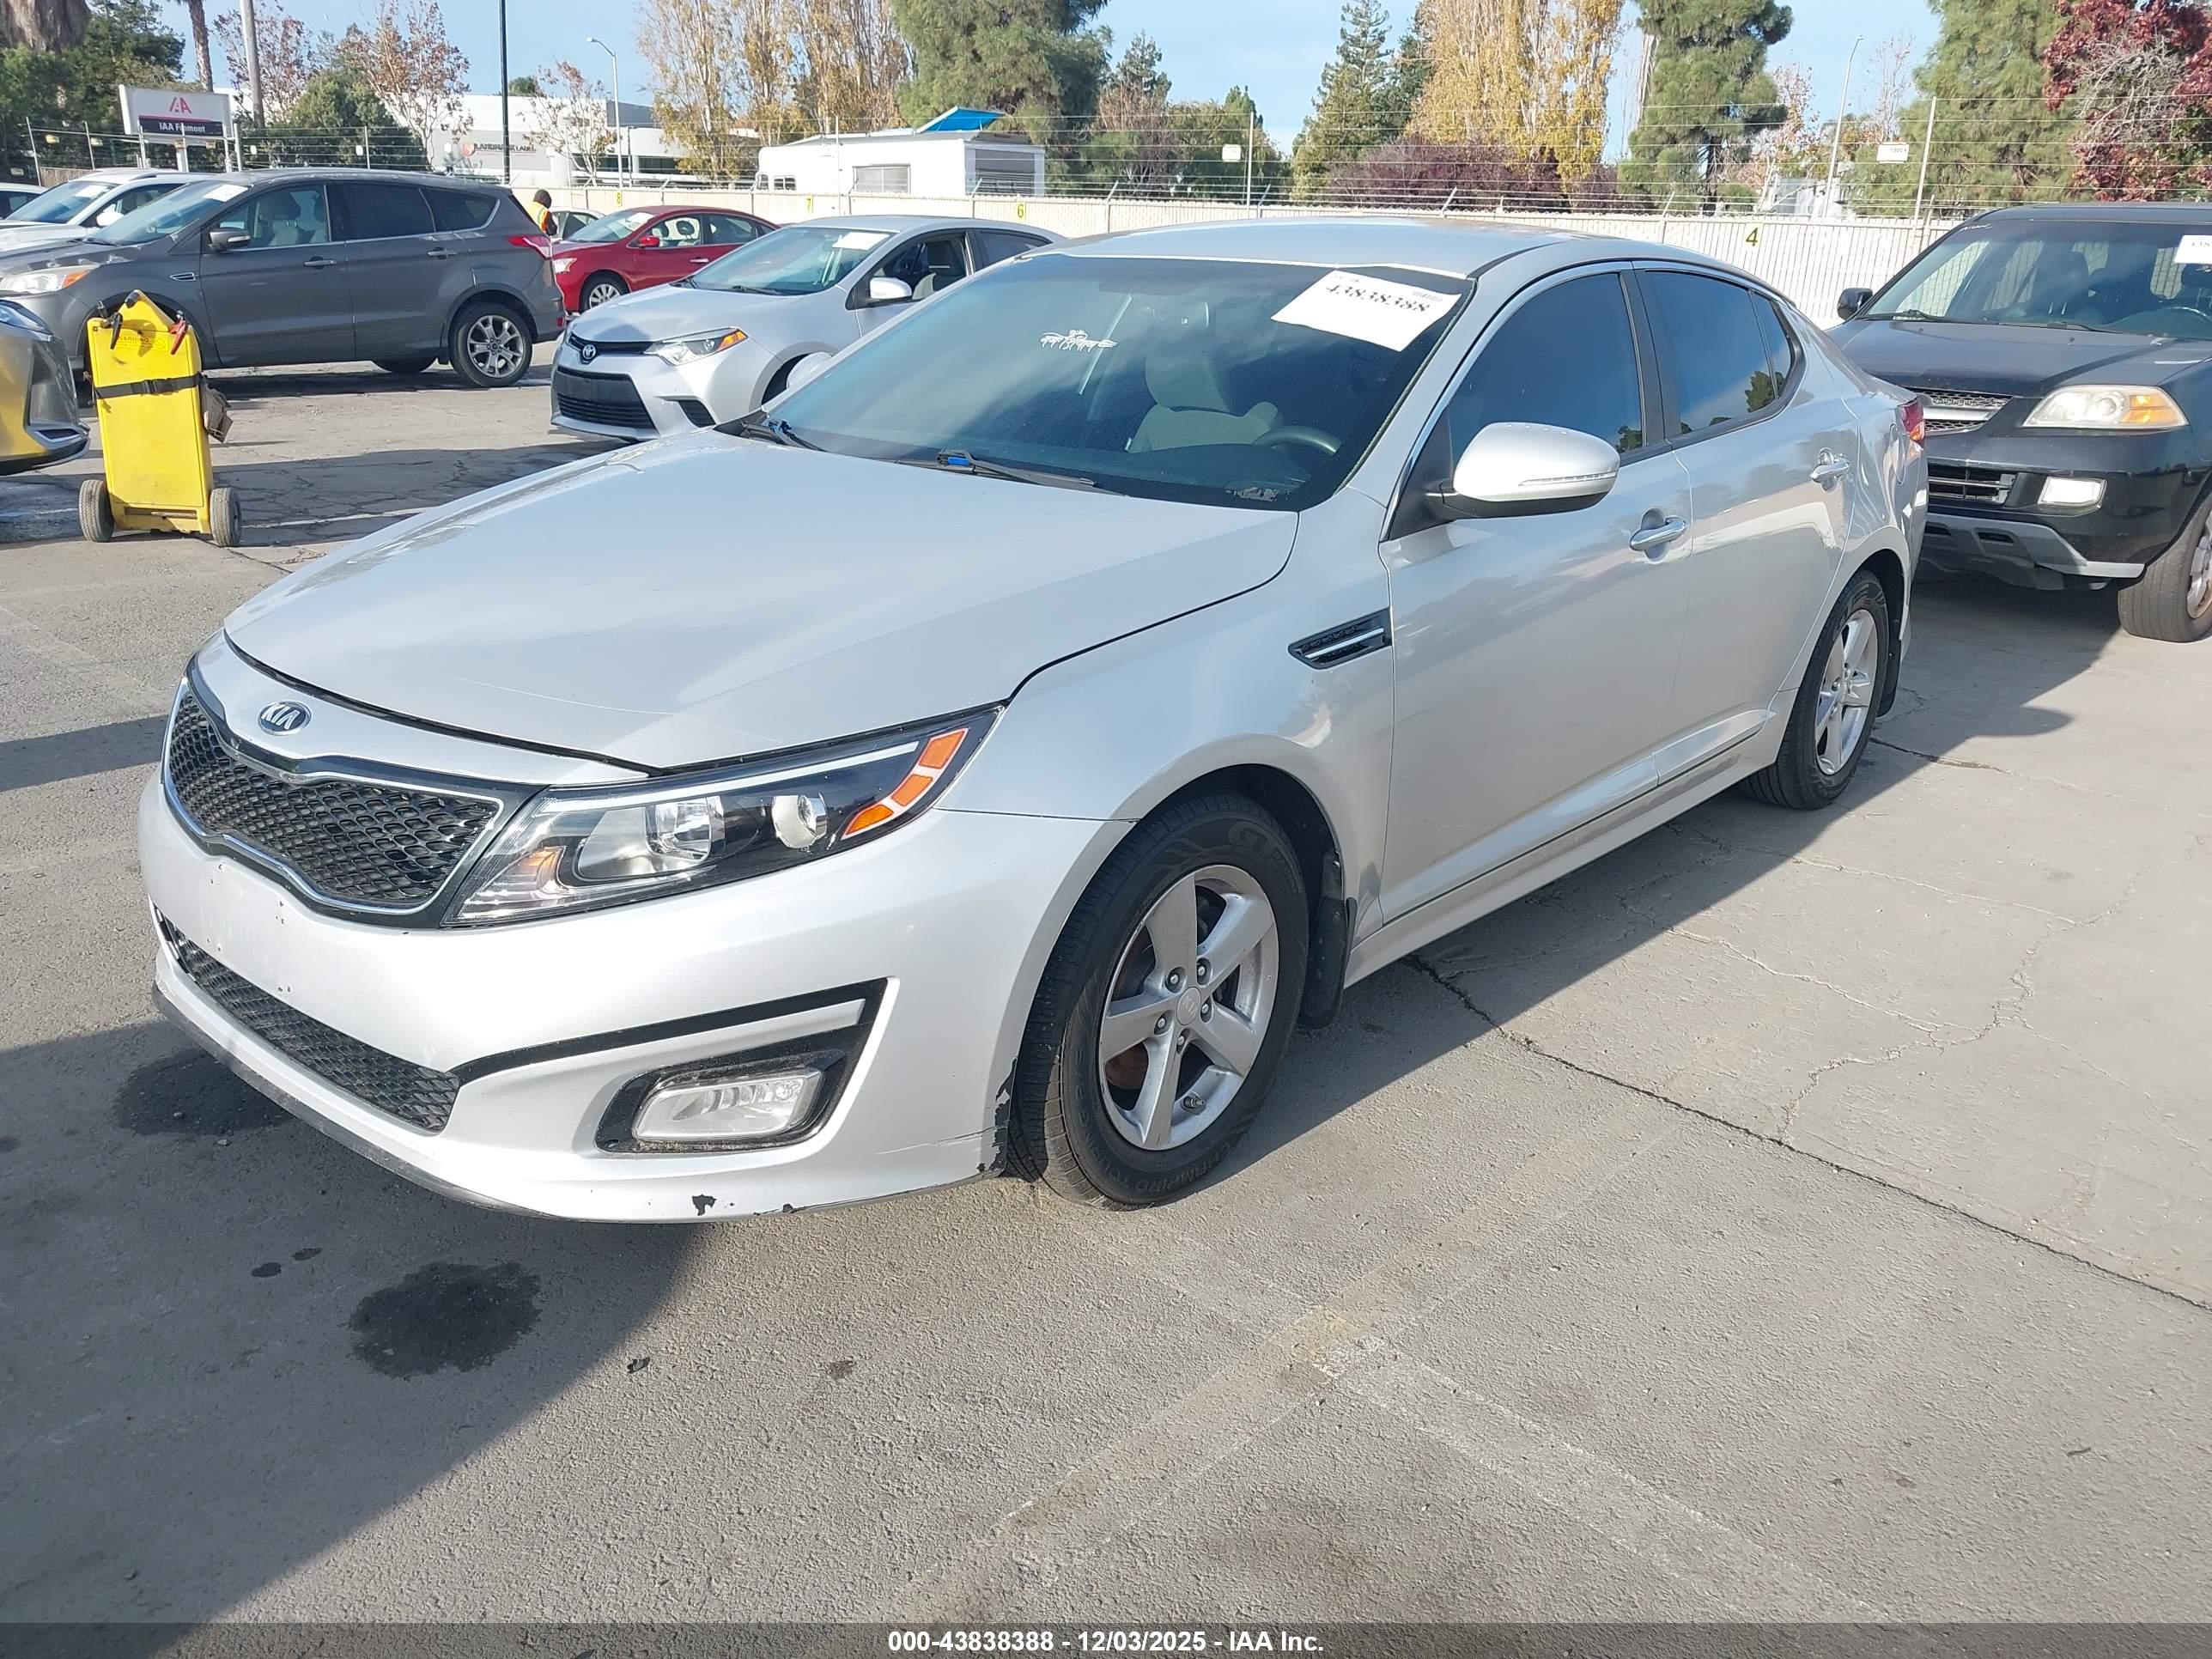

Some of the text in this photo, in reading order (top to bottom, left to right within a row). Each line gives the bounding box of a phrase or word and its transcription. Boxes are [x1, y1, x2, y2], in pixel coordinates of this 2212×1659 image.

[159, 122, 174, 131] IAA
[617, 191, 621, 204] 8
[806, 198, 811, 214] 7
[1017, 203, 1024, 219] 6
[1745, 227, 1759, 247] 4
[1325, 283, 1431, 313] 43838388
[260, 703, 301, 731] KIA
